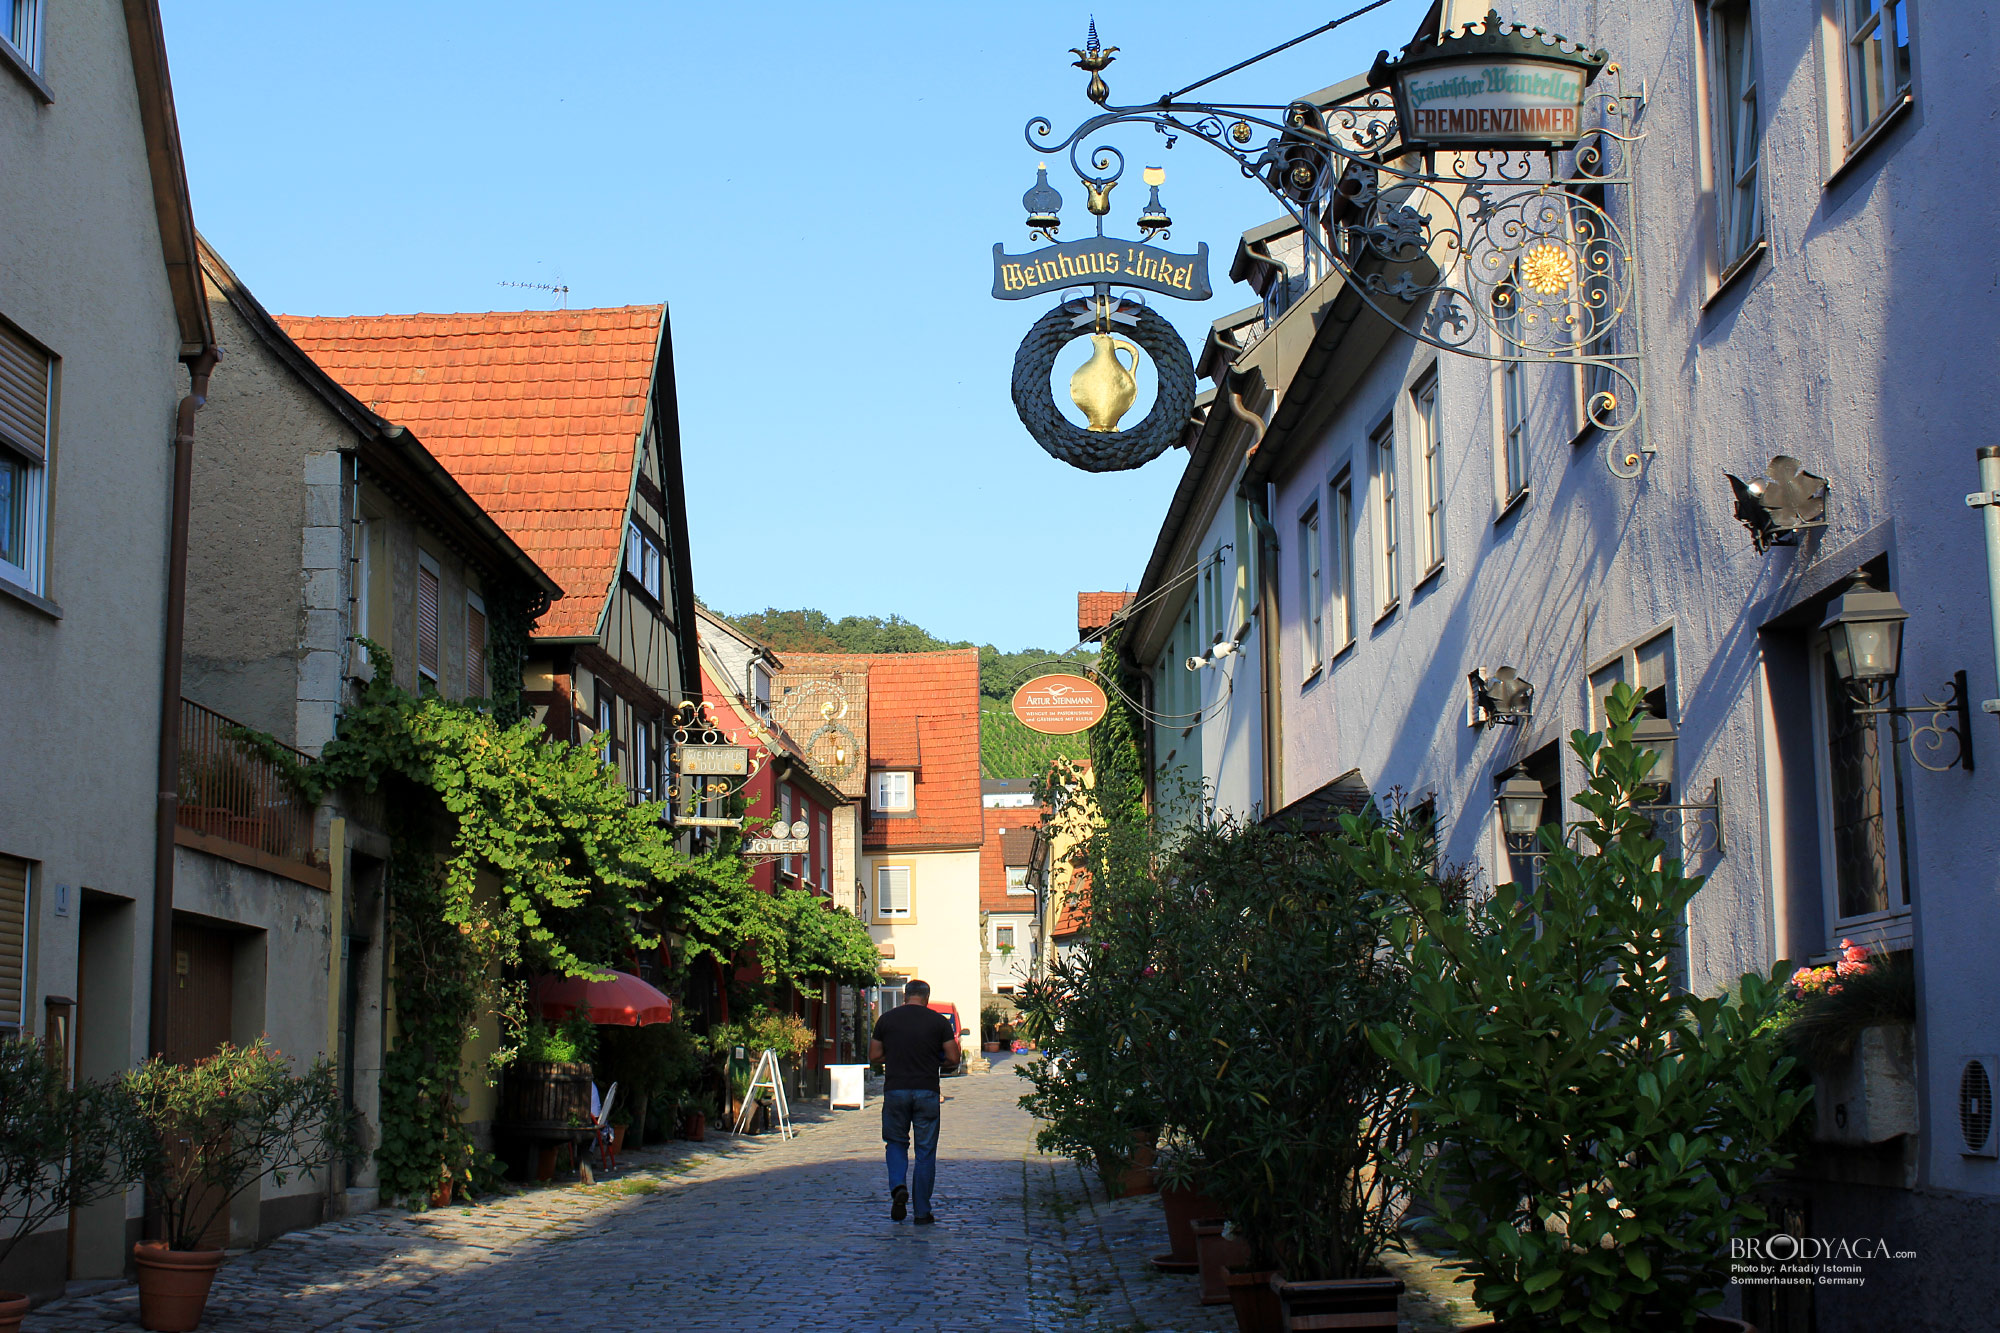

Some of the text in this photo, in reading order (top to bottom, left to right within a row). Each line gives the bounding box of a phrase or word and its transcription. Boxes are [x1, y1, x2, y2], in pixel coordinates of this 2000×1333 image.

[1482, 67, 1580, 102] Weinkeller
[1413, 108, 1575, 133] FREMDENZIMMER
[1001, 248, 1194, 291] Weinhaus Unkel
[1026, 694, 1093, 705] ARTUR STEINMANN
[686, 750, 745, 761] WEINHAUS
